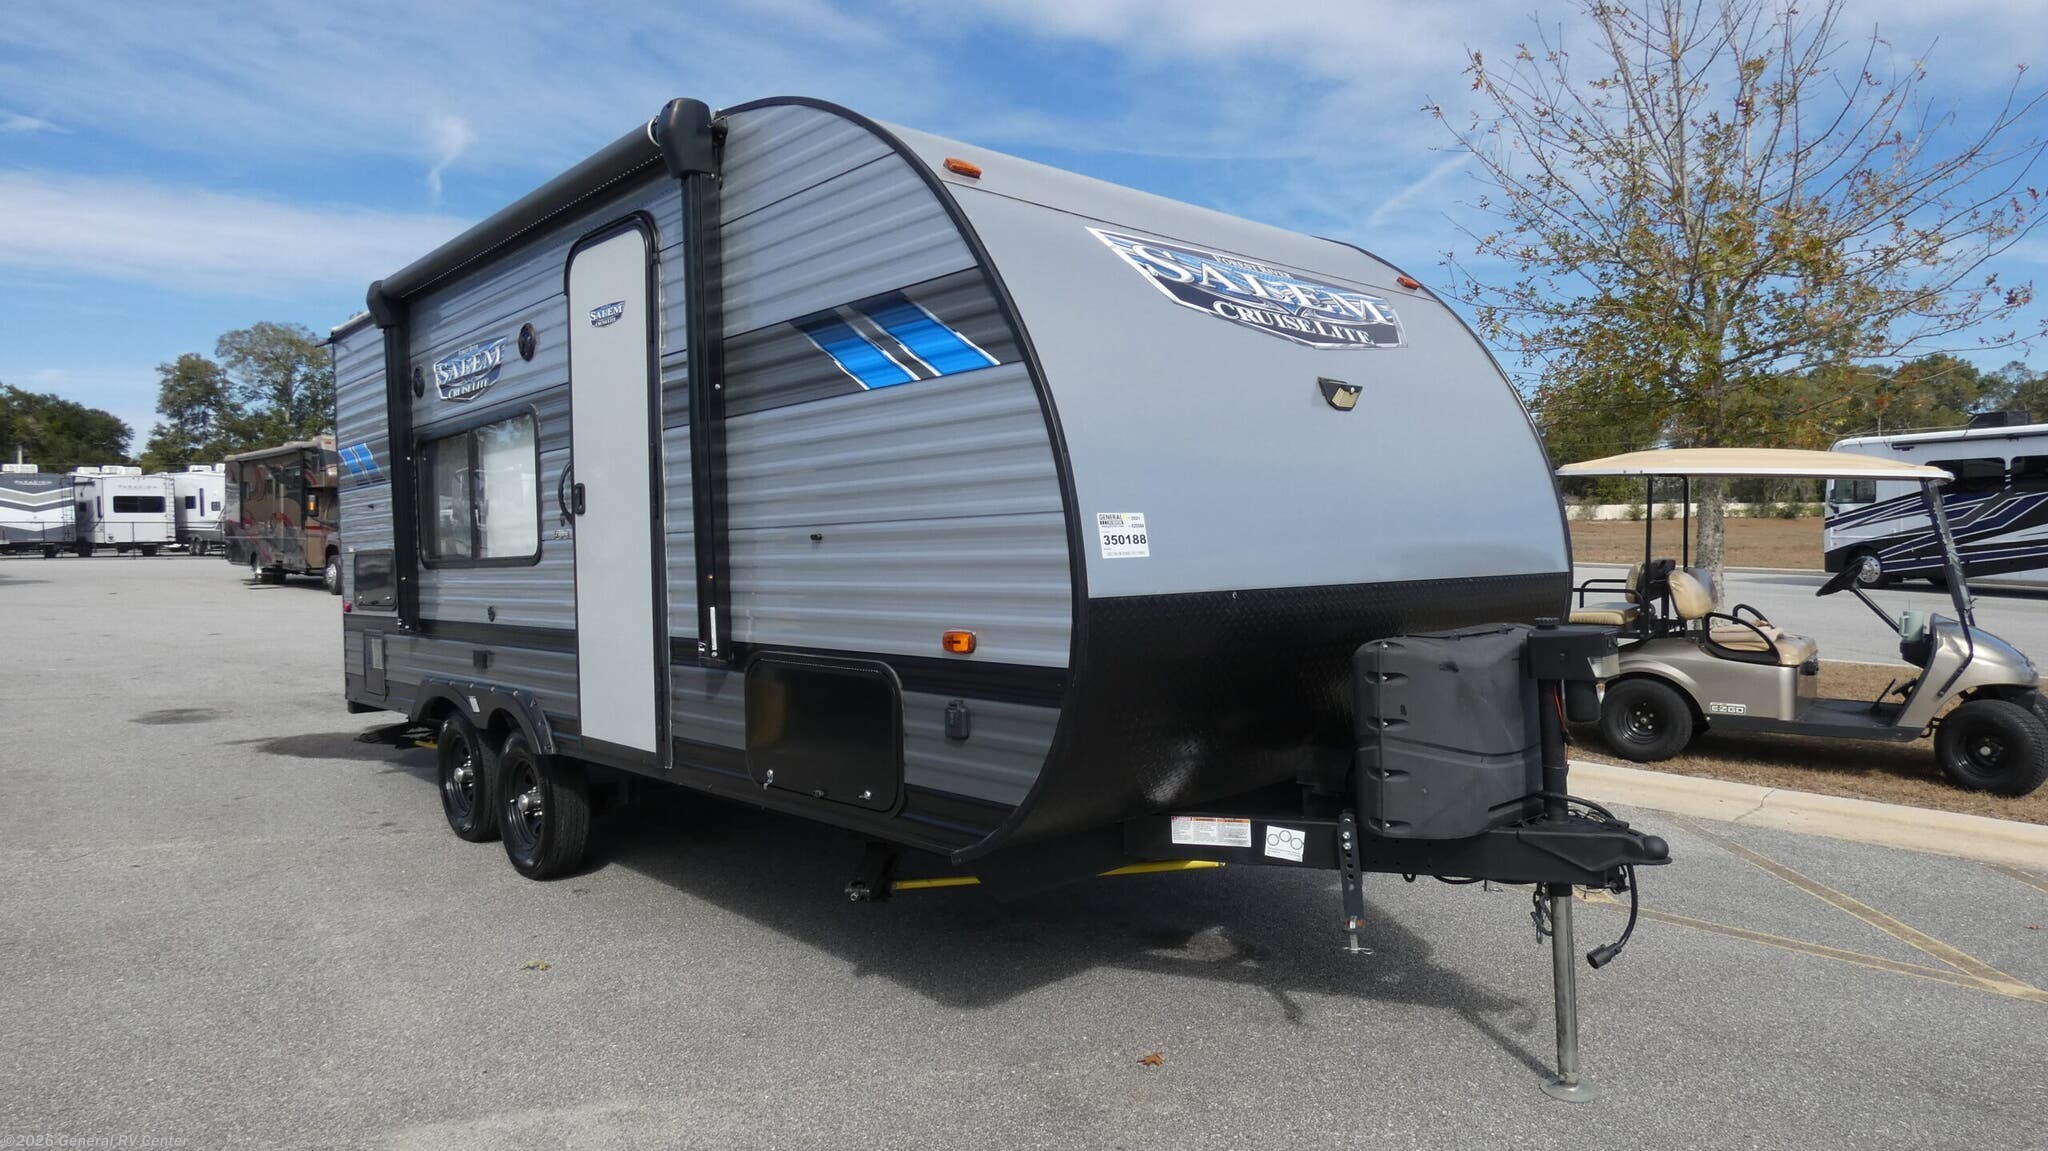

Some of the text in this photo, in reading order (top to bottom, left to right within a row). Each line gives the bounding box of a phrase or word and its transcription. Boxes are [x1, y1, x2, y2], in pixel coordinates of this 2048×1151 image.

[1131, 243, 1394, 325] SALEM
[590, 304, 623, 321] SALEM
[437, 345, 501, 385] SALEM
[1103, 534, 1146, 545] 350188
